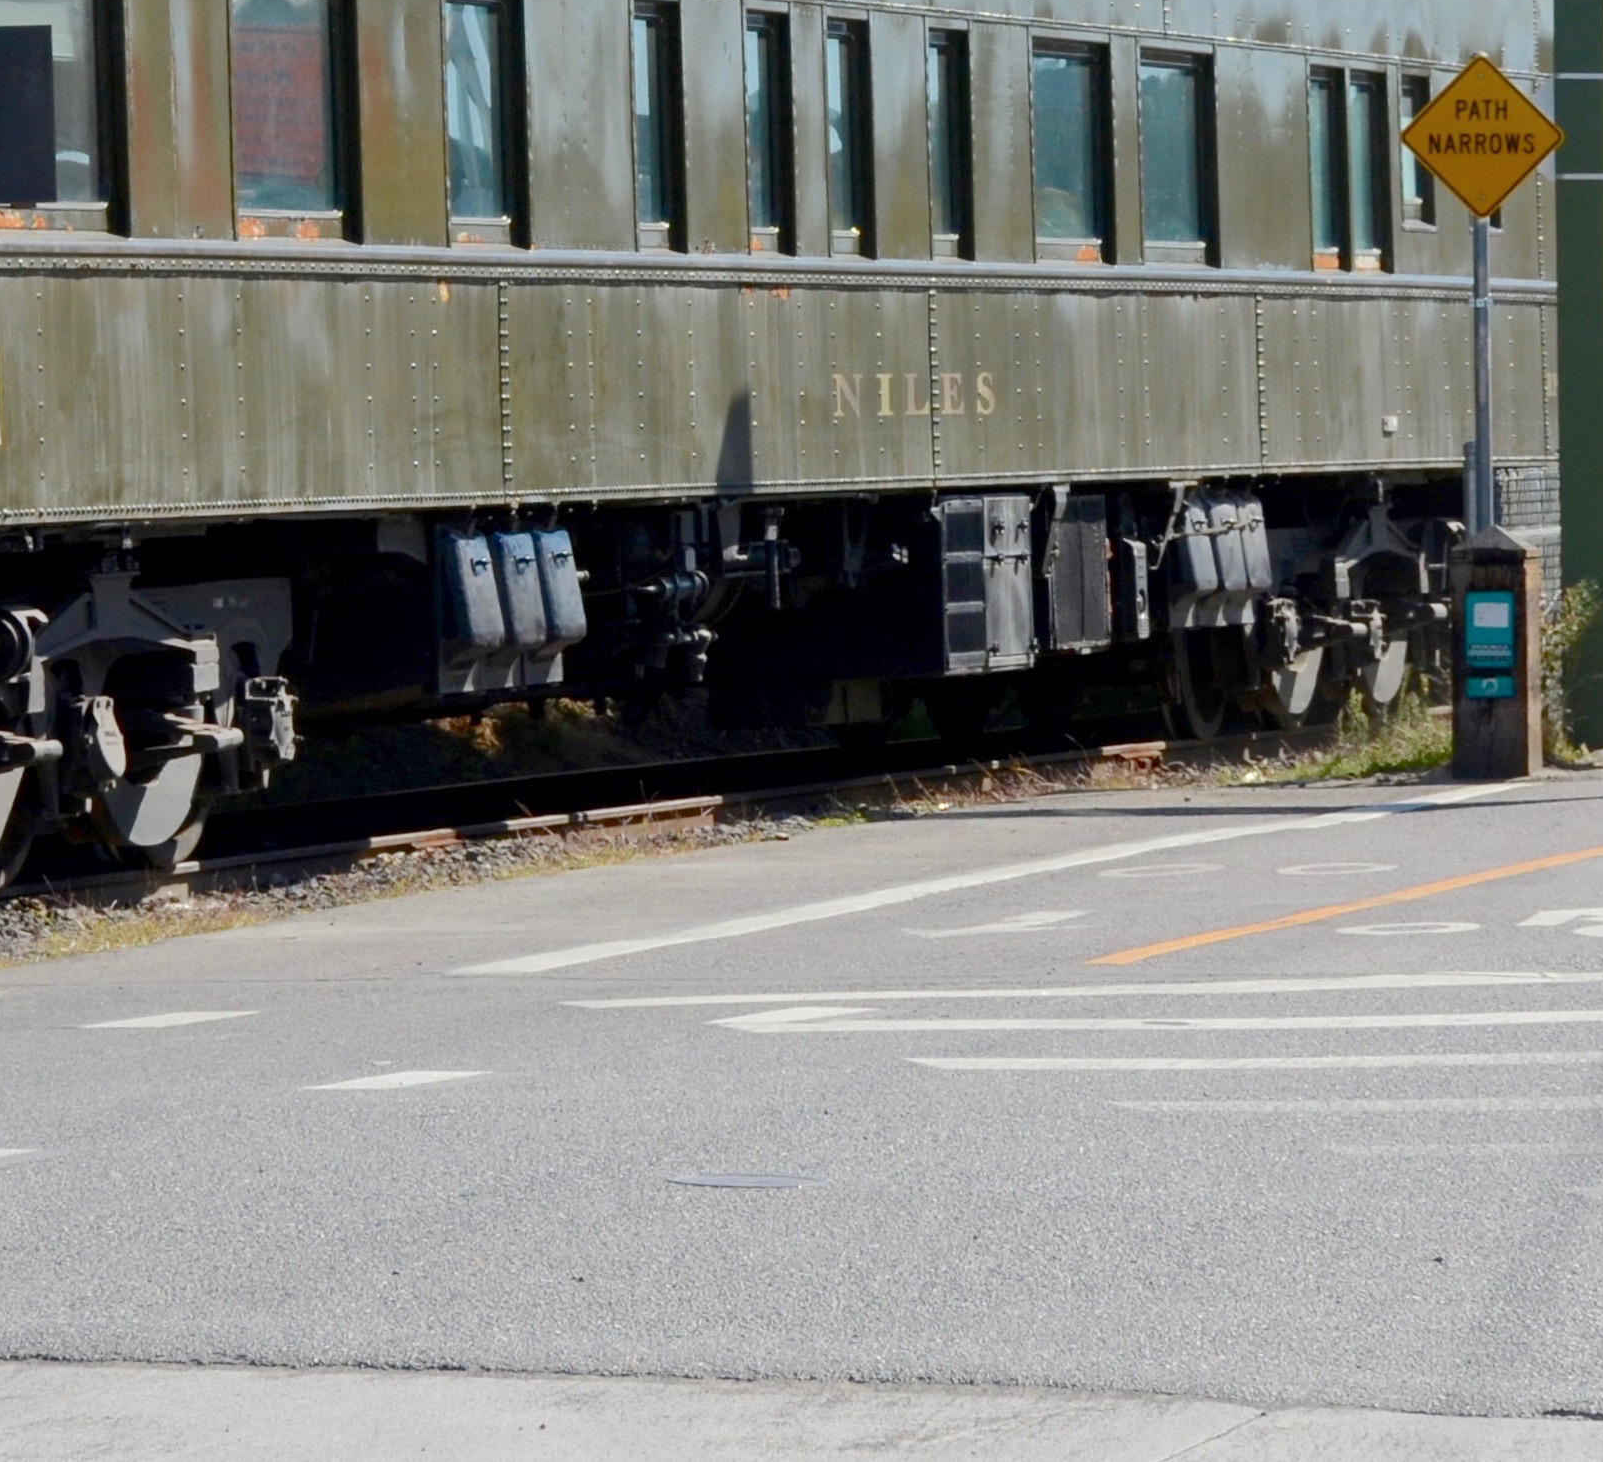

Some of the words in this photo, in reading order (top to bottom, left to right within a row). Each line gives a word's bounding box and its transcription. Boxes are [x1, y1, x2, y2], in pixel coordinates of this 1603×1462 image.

[1455, 99, 1508, 120] PATH
[1428, 133, 1535, 154] NARROWS
[832, 371, 996, 417] NILES
